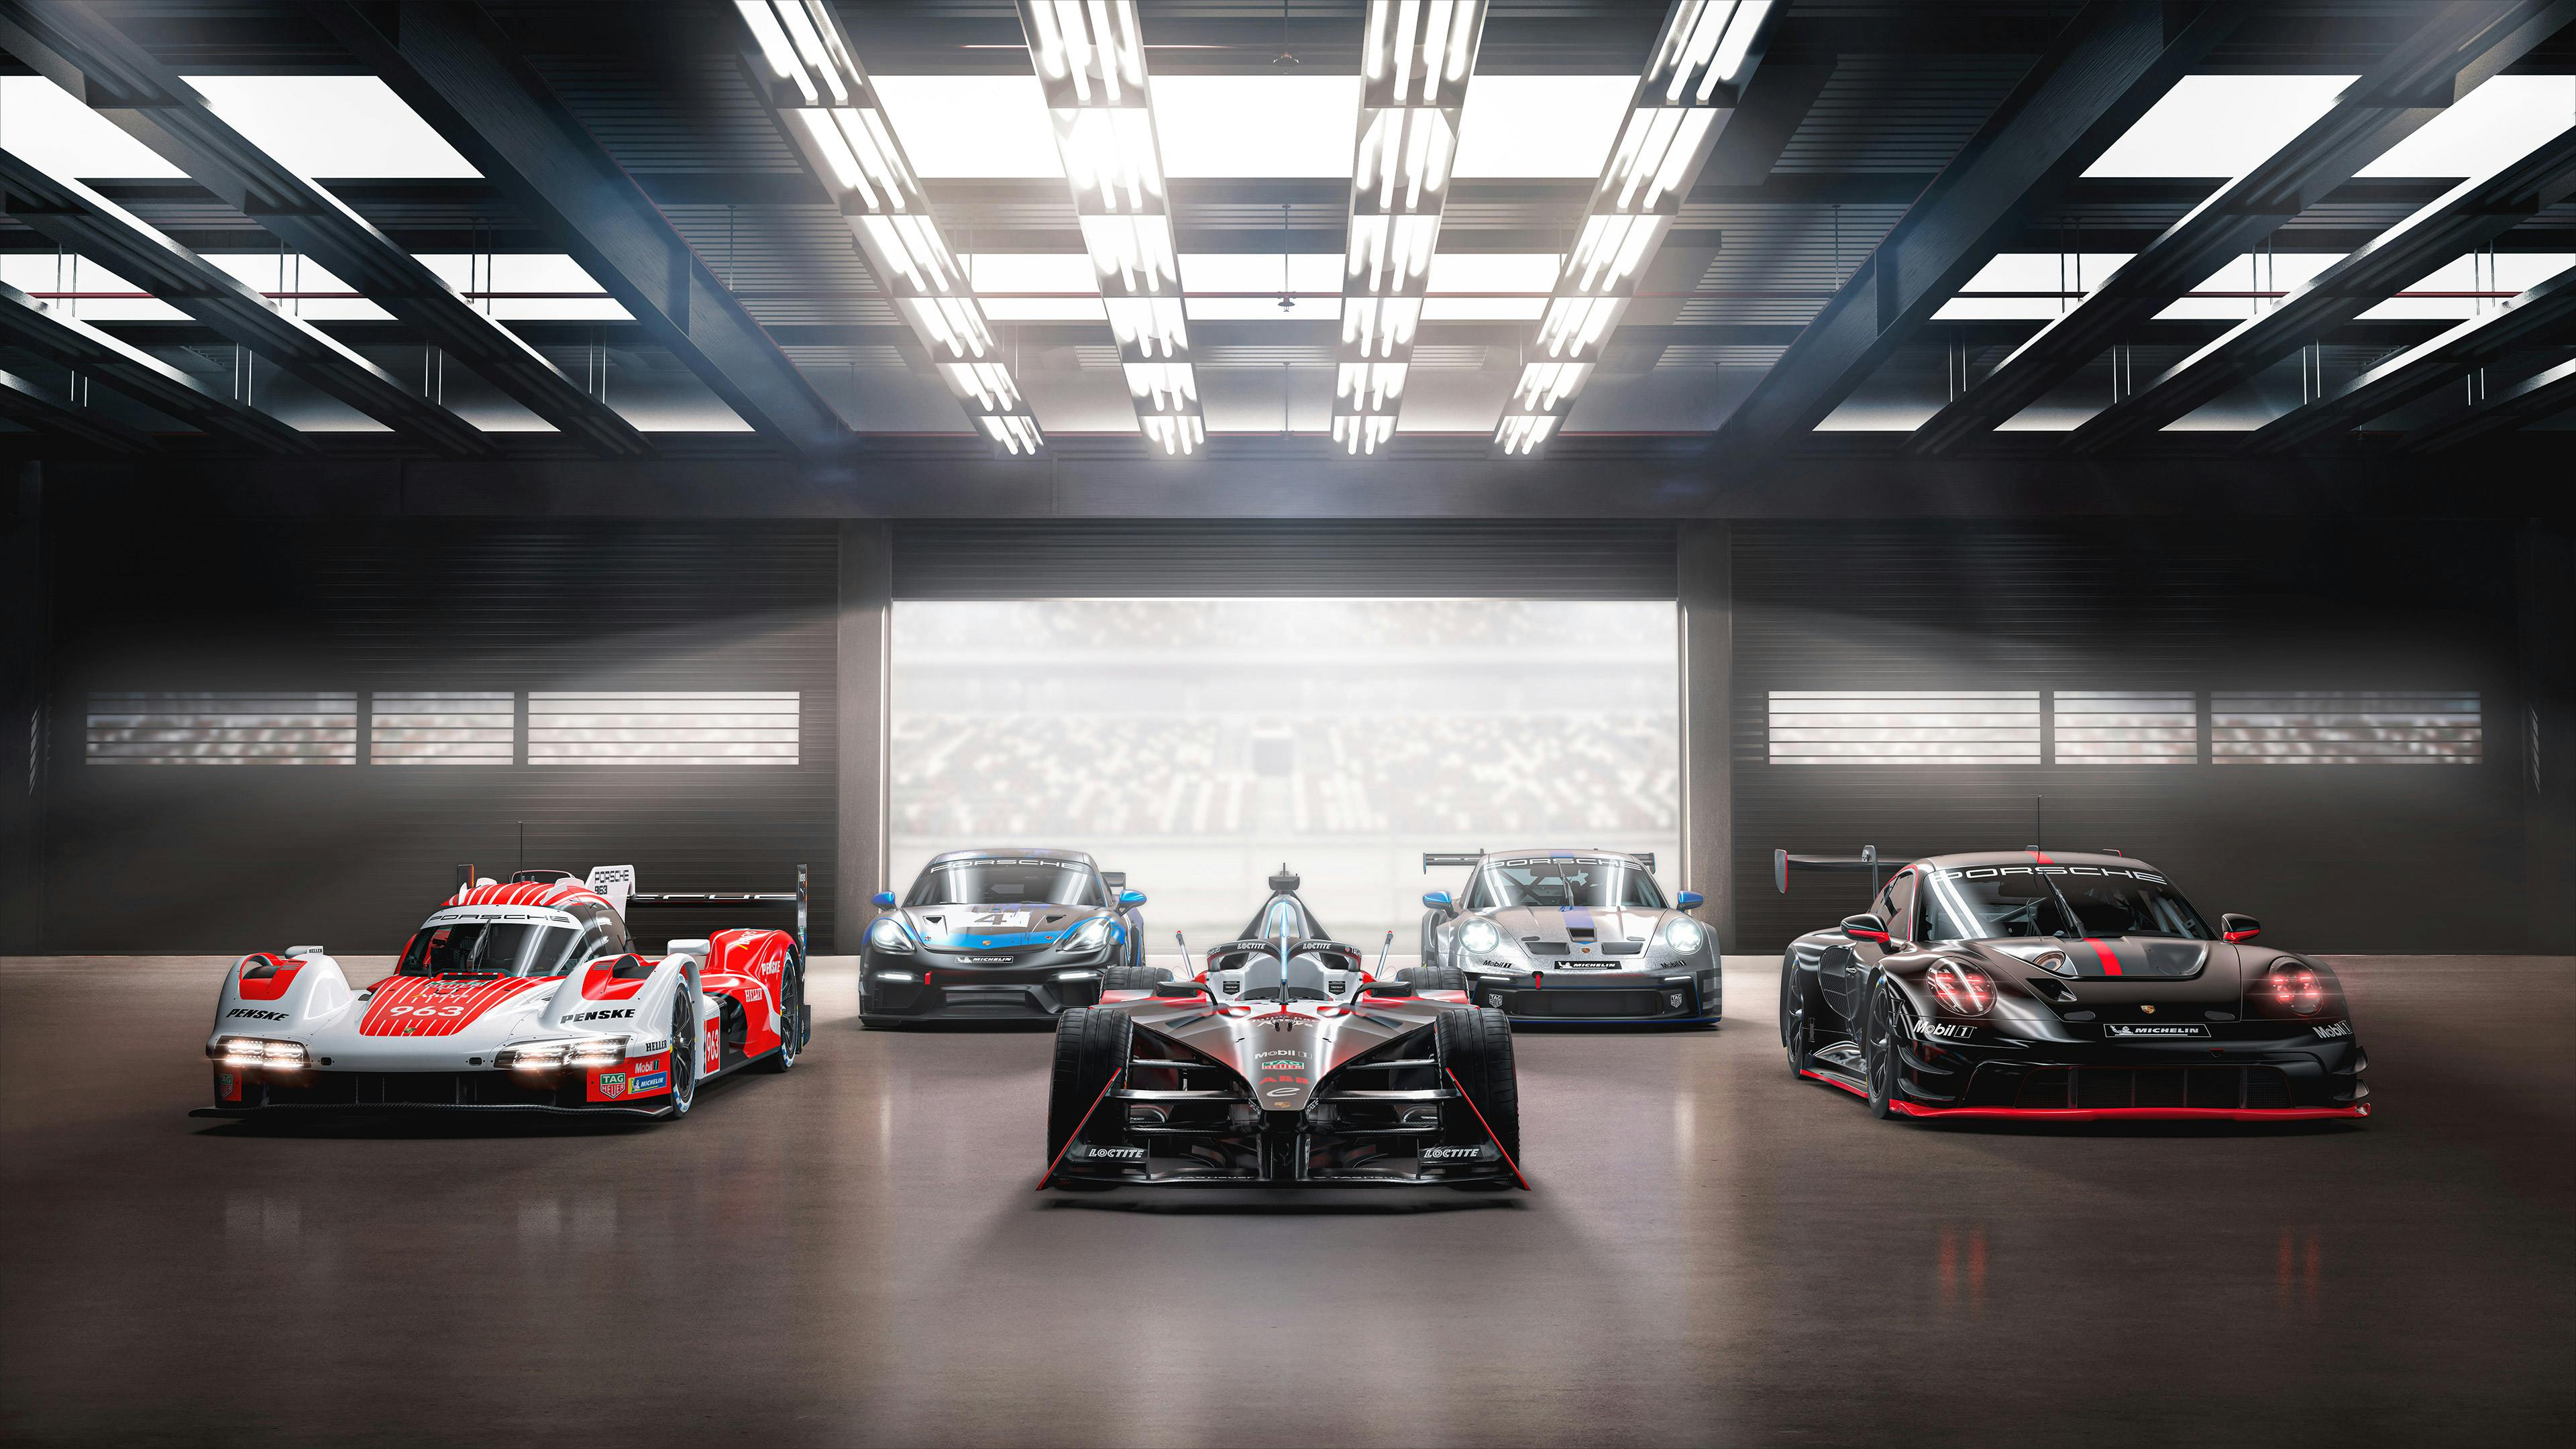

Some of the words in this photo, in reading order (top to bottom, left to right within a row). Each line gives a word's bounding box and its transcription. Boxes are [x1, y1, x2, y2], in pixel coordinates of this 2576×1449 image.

[930, 859, 1083, 873] PORSCHE
[1484, 858, 1642, 871] PORSCHE
[595, 869, 629, 883] PORSCHE
[1934, 867, 2167, 885] PORSCHE
[594, 885, 608, 895] 963
[427, 914, 570, 923] PORSCHE
[974, 913, 1007, 925] 4
[761, 961, 781, 975] PENSKE
[1660, 961, 1680, 969] Mobil
[745, 987, 763, 1002] HELLER
[226, 1008, 289, 1021] PENSKE
[390, 1006, 464, 1016] 963
[560, 1009, 635, 1024] PENSKE
[1913, 1020, 1956, 1036] Mobil
[2312, 1023, 2347, 1038] Mobil
[645, 1040, 667, 1052] HELLER
[707, 1029, 719, 1062] 963
[1254, 1050, 1295, 1059] Mobil
[635, 1062, 653, 1073] Mobil
[604, 1075, 624, 1083] TAG
[641, 1077, 664, 1087] MICHELIN
[602, 1084, 625, 1096] HEUER
[1089, 1148, 1144, 1158] LOCTITE
[1424, 1148, 1479, 1158] LOCTITE
